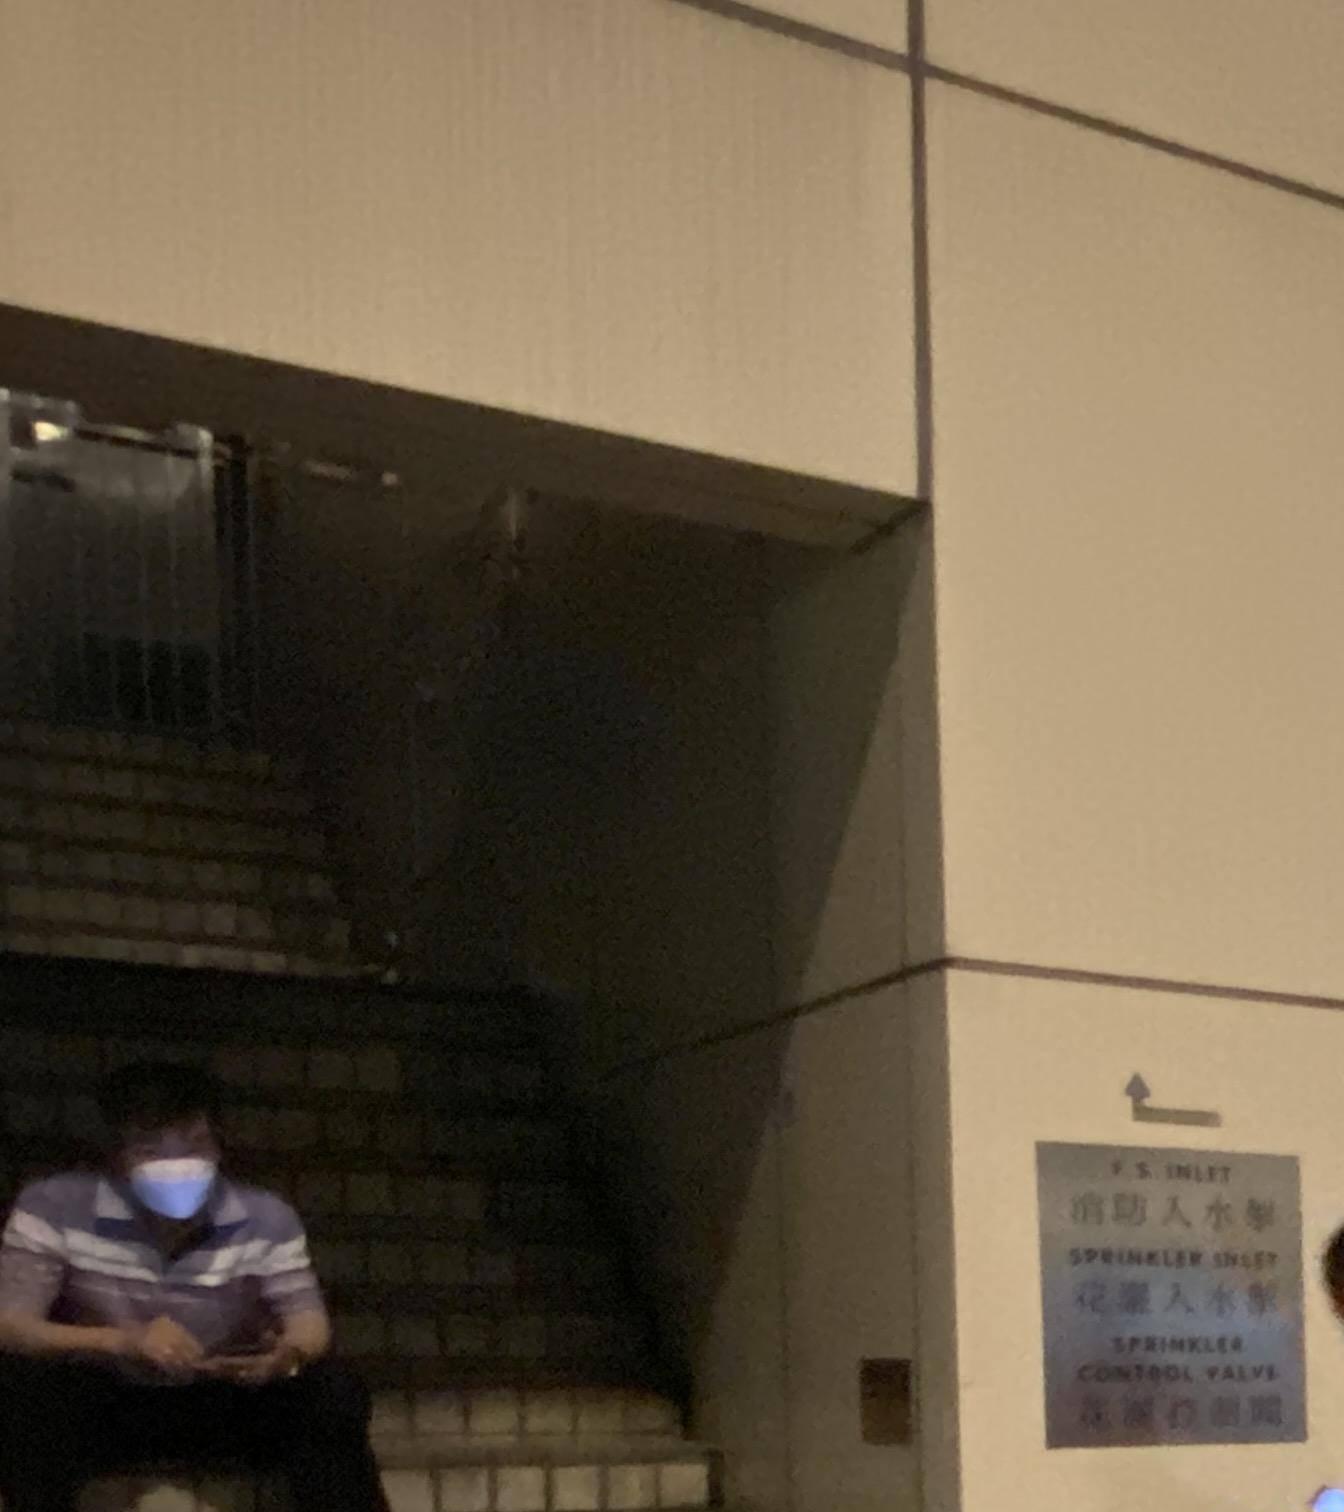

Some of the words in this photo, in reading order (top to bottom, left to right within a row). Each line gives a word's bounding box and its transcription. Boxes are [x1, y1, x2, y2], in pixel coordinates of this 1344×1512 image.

[1165, 1163, 1233, 1183] INLET
[1069, 1247, 1204, 1270] SPRINKLER
[1110, 1335, 1244, 1355] SPRINKLER
[1076, 1362, 1195, 1385] CONTROL
[1206, 1362, 1280, 1383] VALVE
